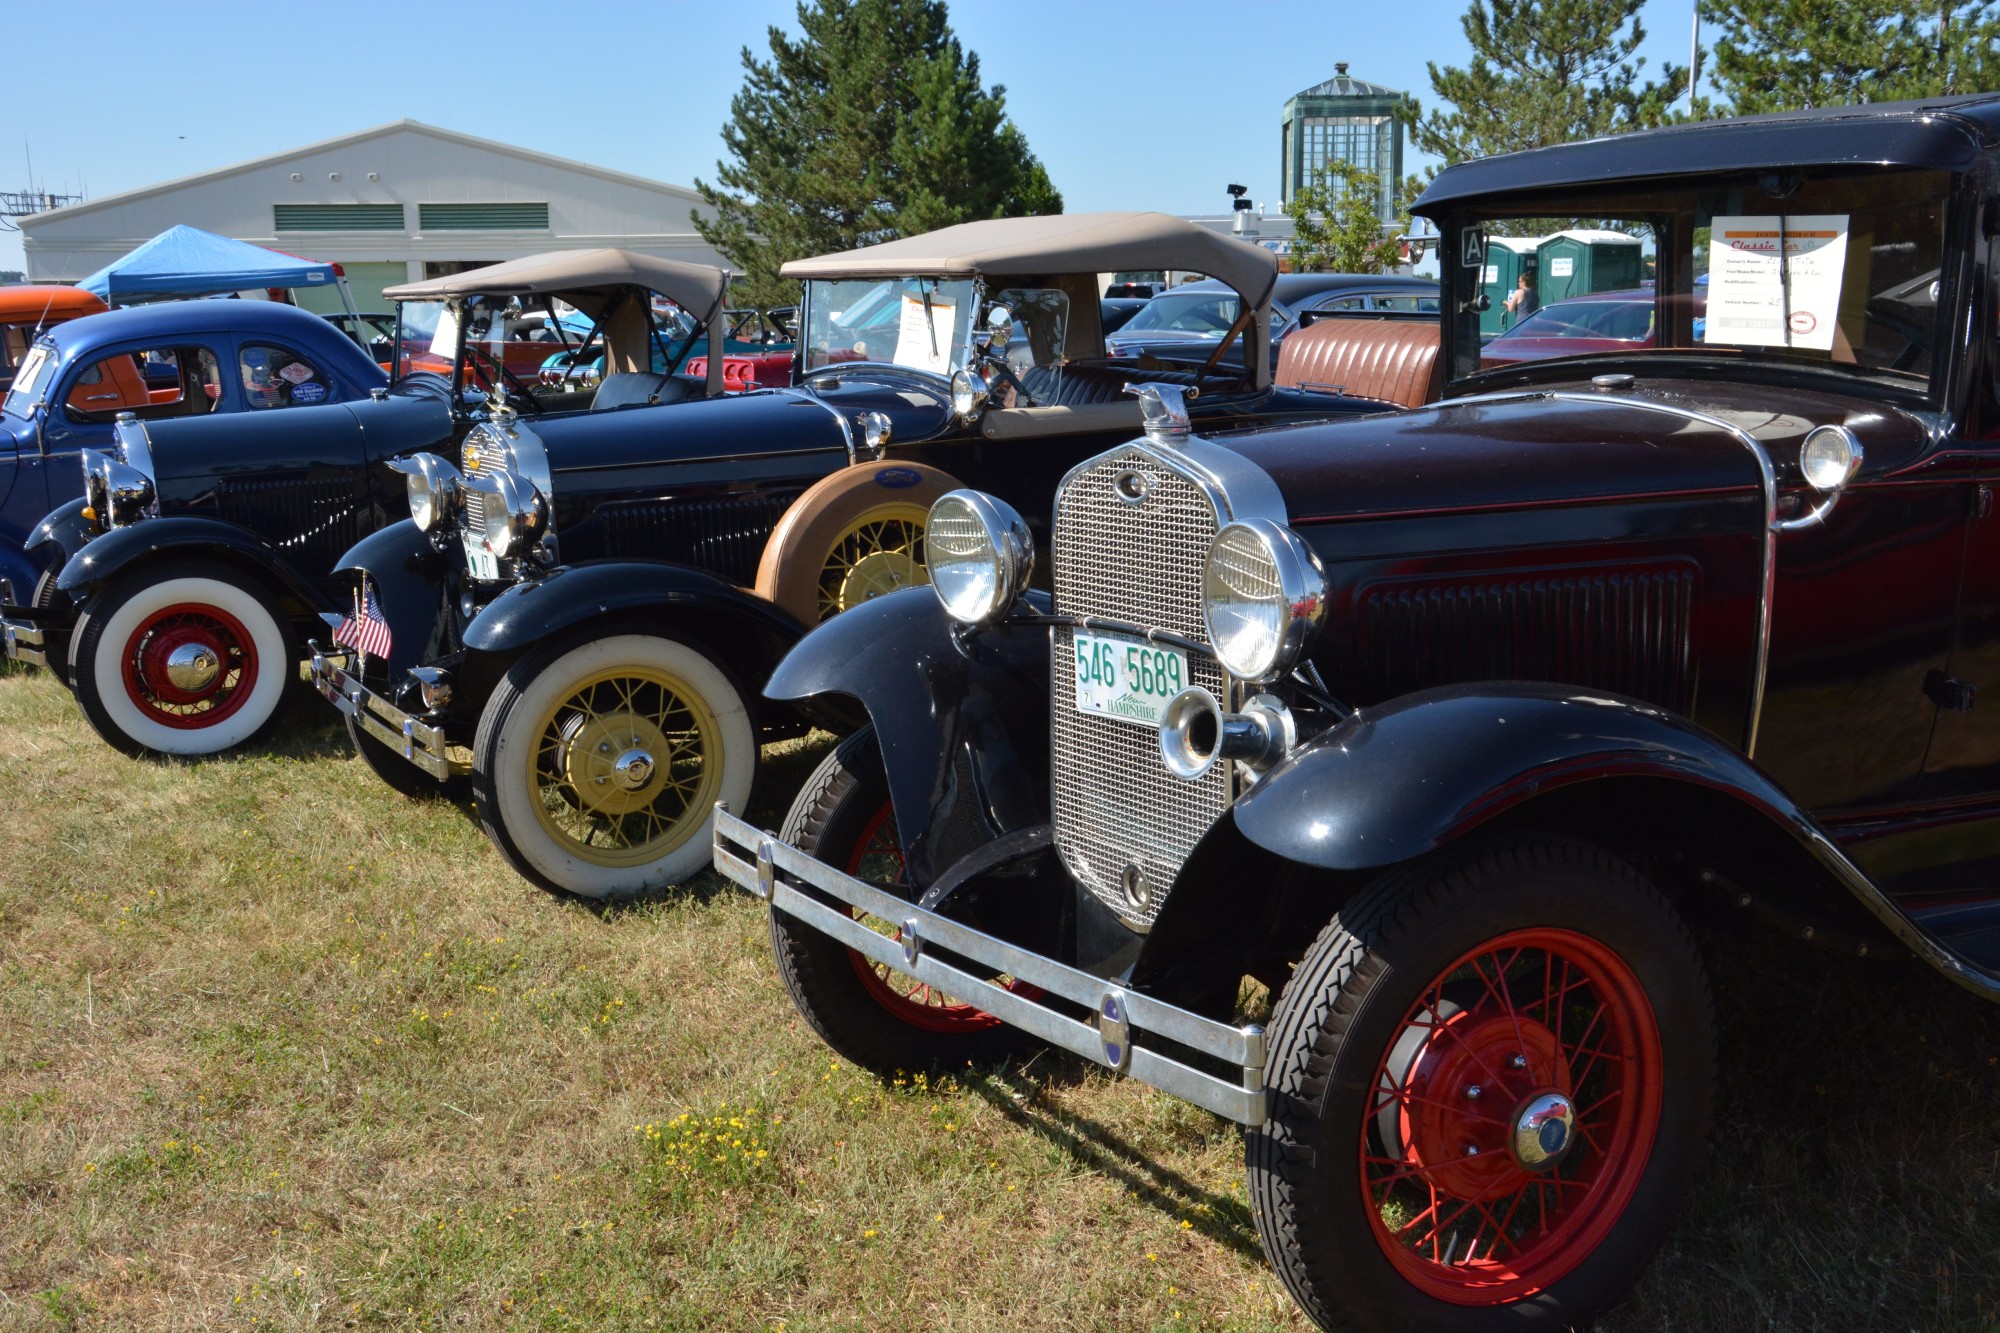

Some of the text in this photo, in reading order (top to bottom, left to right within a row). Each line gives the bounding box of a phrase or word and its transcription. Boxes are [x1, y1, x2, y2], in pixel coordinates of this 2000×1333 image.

[1466, 232, 1481, 259] A
[1731, 240, 1775, 250] Classic
[1077, 639, 1181, 697] 546 5689
[1084, 692, 1089, 702] 7
[1107, 698, 1158, 720] HAMPSHIRE
